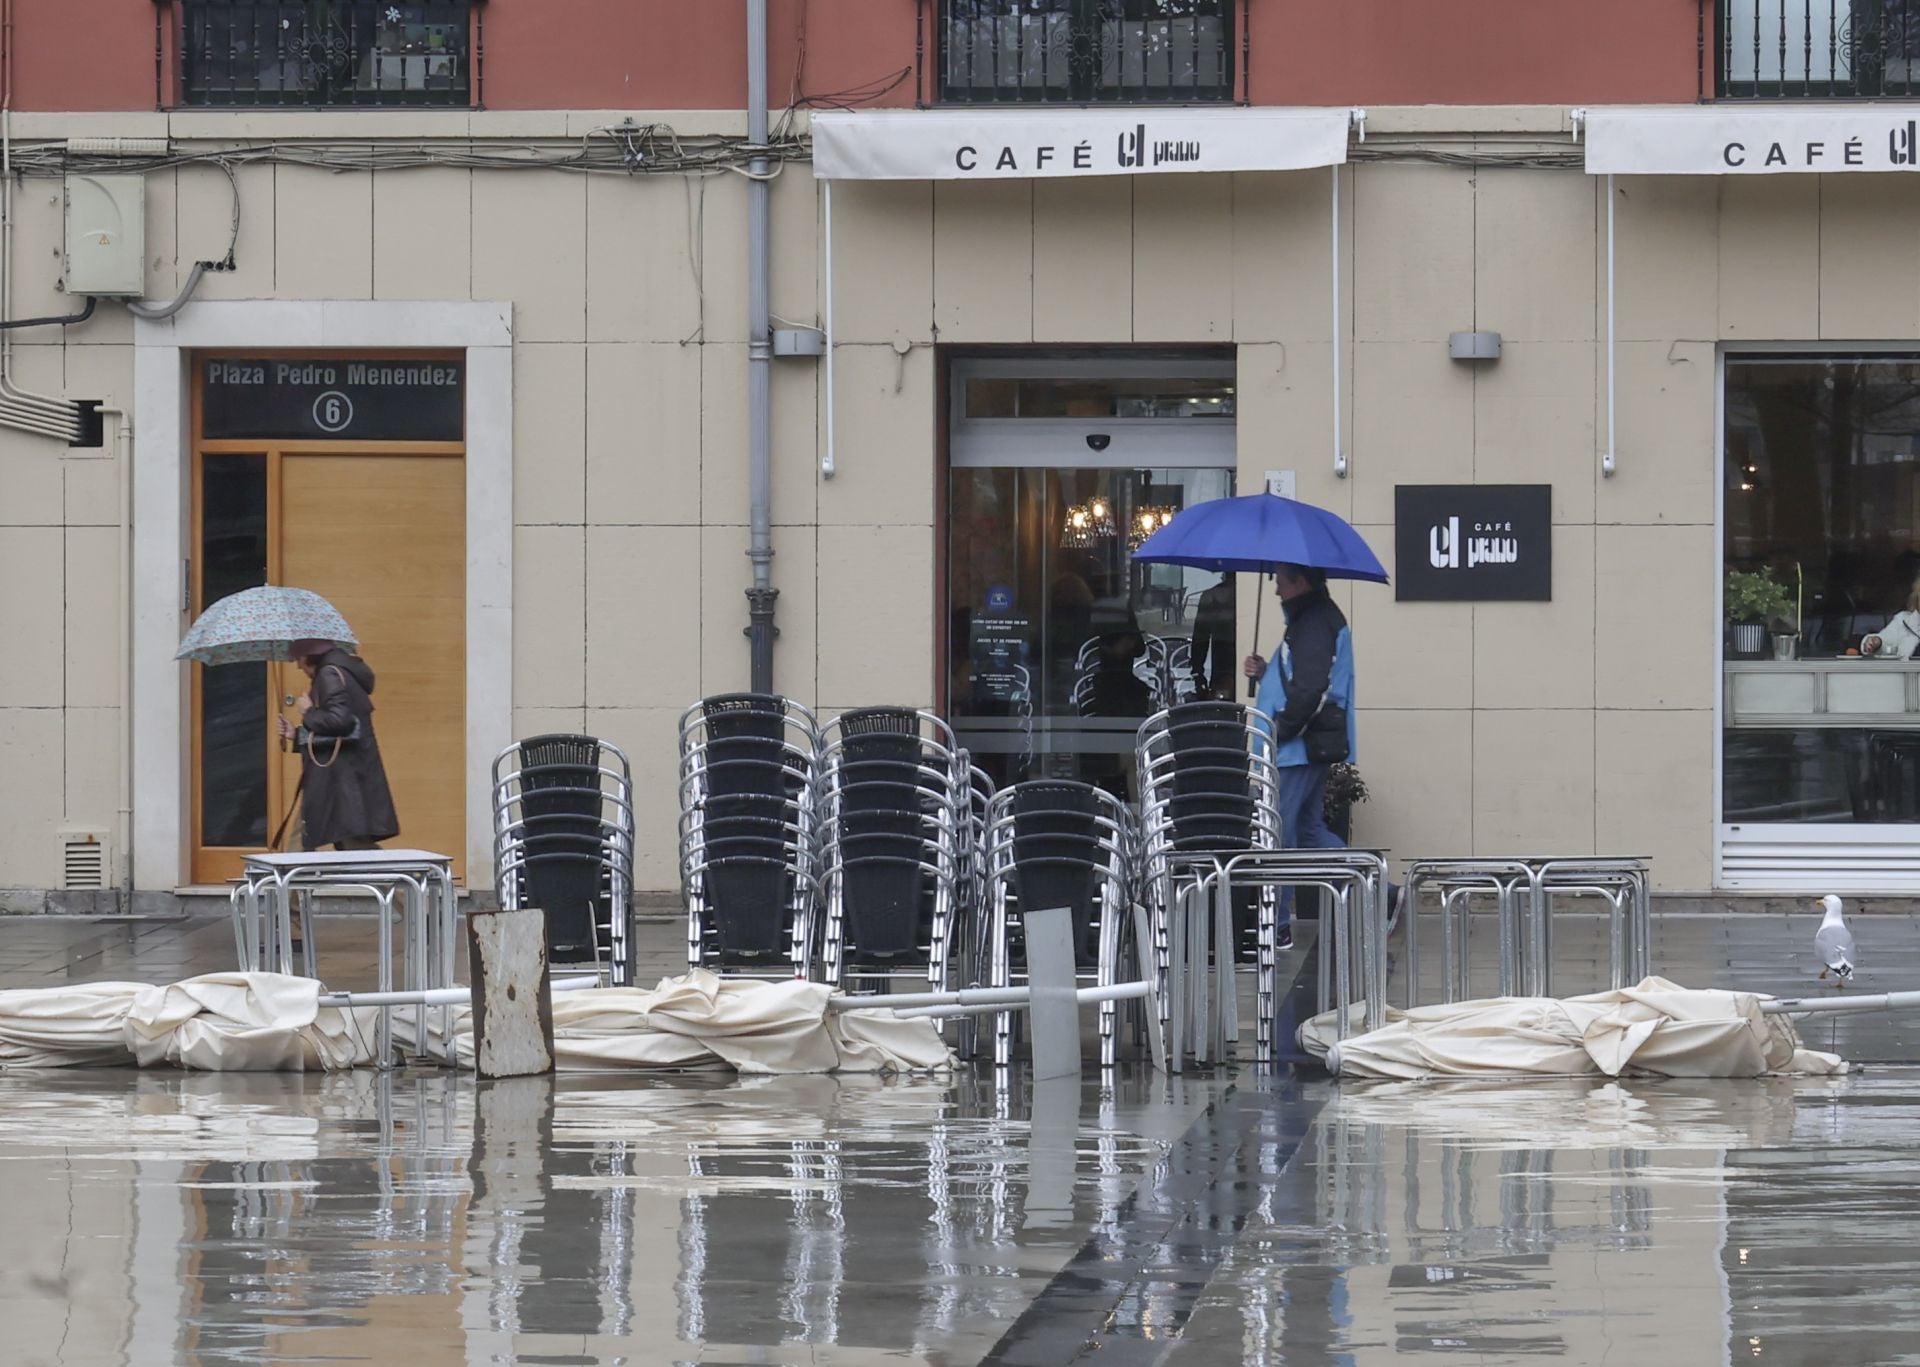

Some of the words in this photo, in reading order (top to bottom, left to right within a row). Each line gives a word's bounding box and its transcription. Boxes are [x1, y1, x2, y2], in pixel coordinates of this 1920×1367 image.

[956, 140, 1092, 170] CAFÉ
[1118, 124, 1145, 167] el
[1153, 140, 1200, 166] piano
[1723, 136, 1864, 167] CAFÉ
[209, 362, 265, 385] Plaza
[276, 363, 336, 386] Pedro
[347, 363, 458, 386] Menendez
[325, 398, 341, 424] 6
[1474, 521, 1512, 531] CAFÉ
[1430, 516, 1459, 568] el
[1467, 537, 1518, 568] piano
